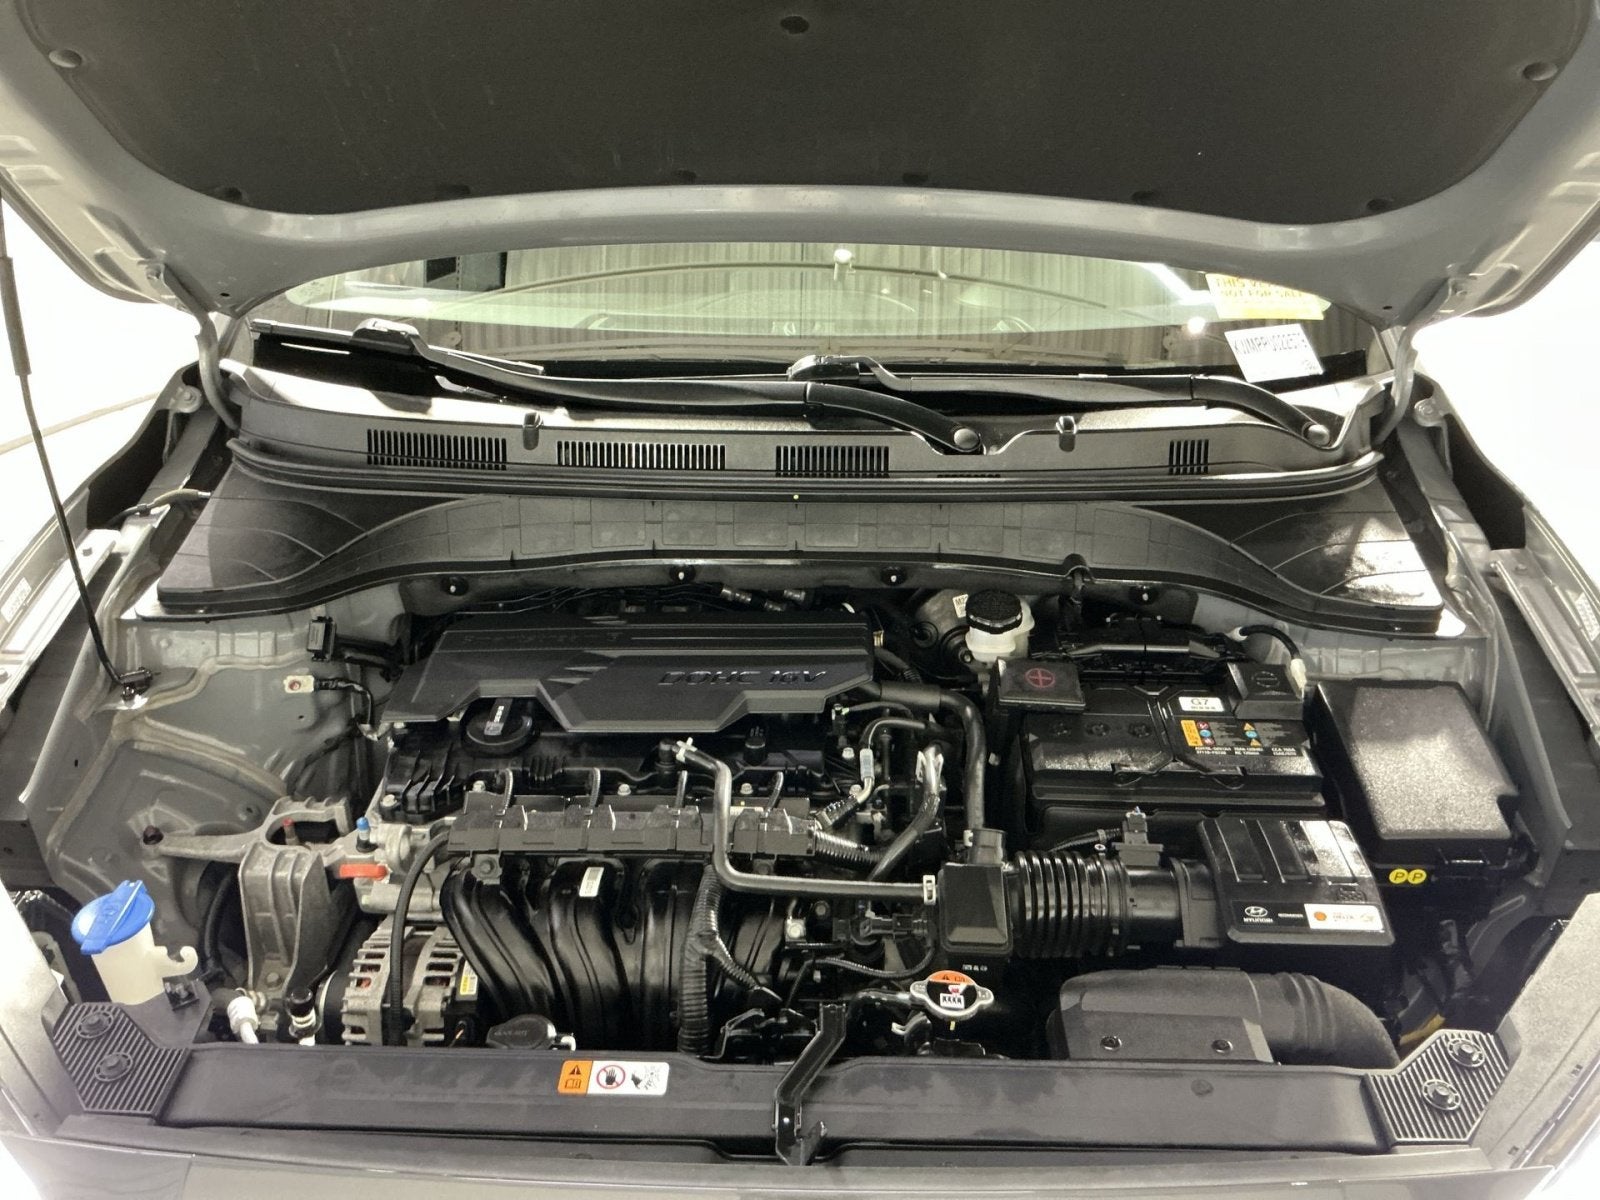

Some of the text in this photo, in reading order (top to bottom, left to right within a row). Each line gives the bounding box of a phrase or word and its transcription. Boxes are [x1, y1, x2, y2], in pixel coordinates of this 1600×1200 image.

[658, 670, 828, 686] DOHC 16V
[1191, 698, 1209, 706] G7
